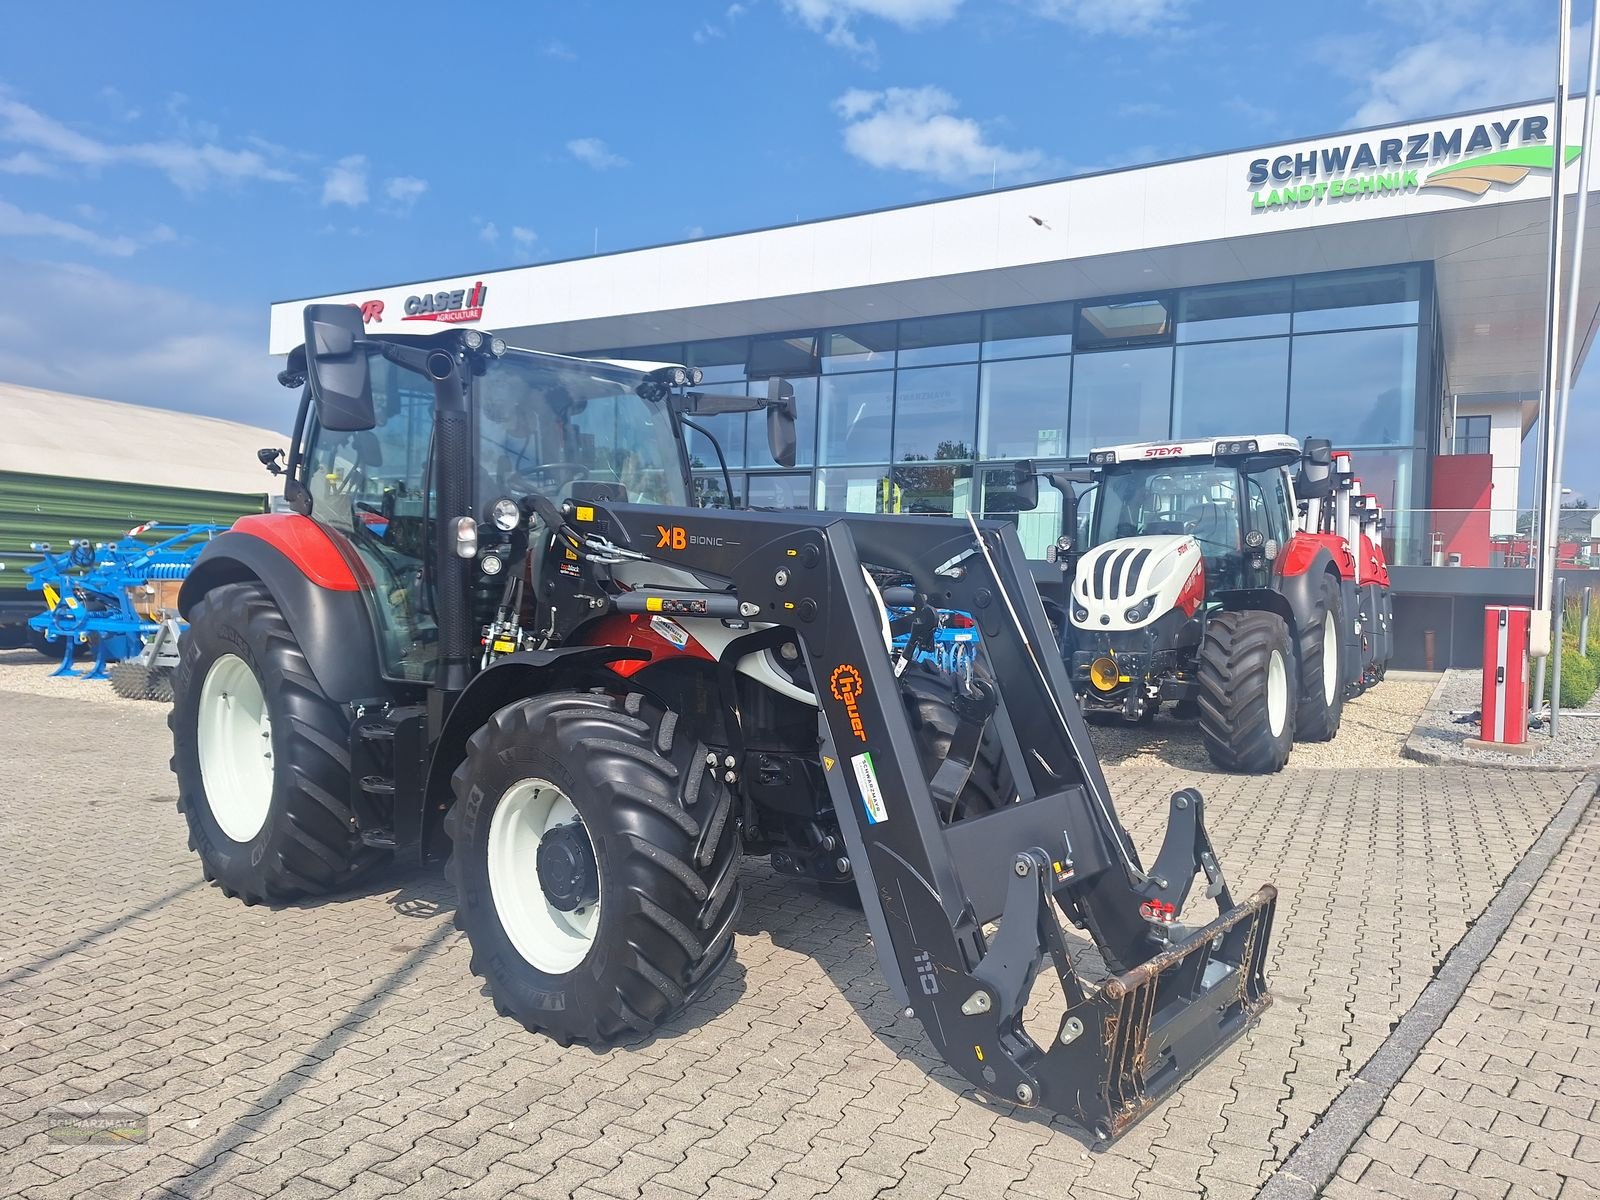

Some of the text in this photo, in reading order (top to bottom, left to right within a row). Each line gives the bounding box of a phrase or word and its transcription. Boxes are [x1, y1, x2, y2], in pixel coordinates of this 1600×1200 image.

[1249, 114, 1549, 184] SCHWARZMAYR
[1253, 169, 1418, 208] LANDTECHNIK
[404, 289, 465, 315] CASE
[436, 310, 478, 321] AGRICULTURE
[1145, 446, 1182, 457] STEYR
[656, 525, 723, 550] XB BIONIC
[838, 676, 868, 742] hauer
[861, 759, 881, 812] SCHWARZMAYR
[914, 951, 939, 995] 110
